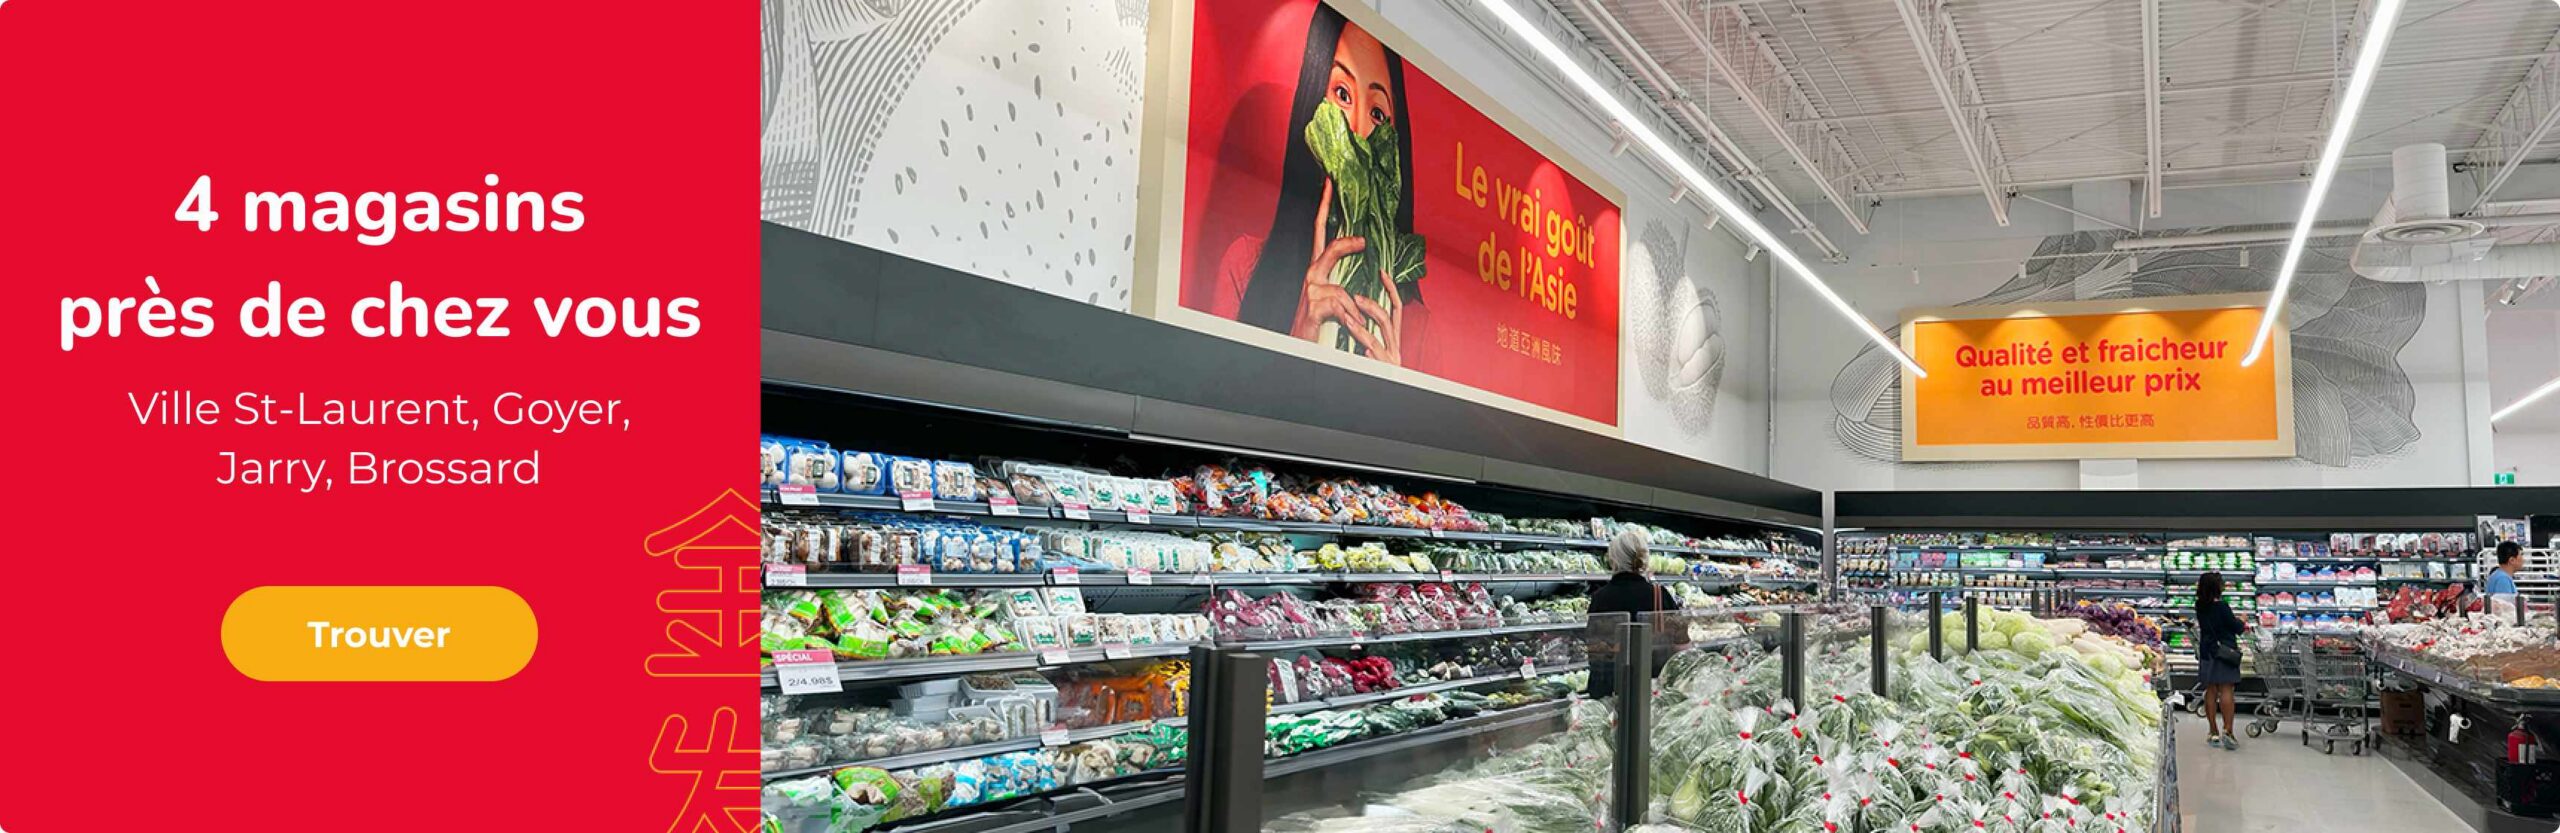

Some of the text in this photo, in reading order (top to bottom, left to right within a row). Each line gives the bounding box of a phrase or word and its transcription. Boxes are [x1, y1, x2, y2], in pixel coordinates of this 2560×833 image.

[1455, 141, 1596, 269] Le vrai goût
[1477, 231, 1513, 291] de
[1955, 336, 2229, 368] Qualité et fraicheur
[1980, 368, 2201, 397] au meilleur prix
